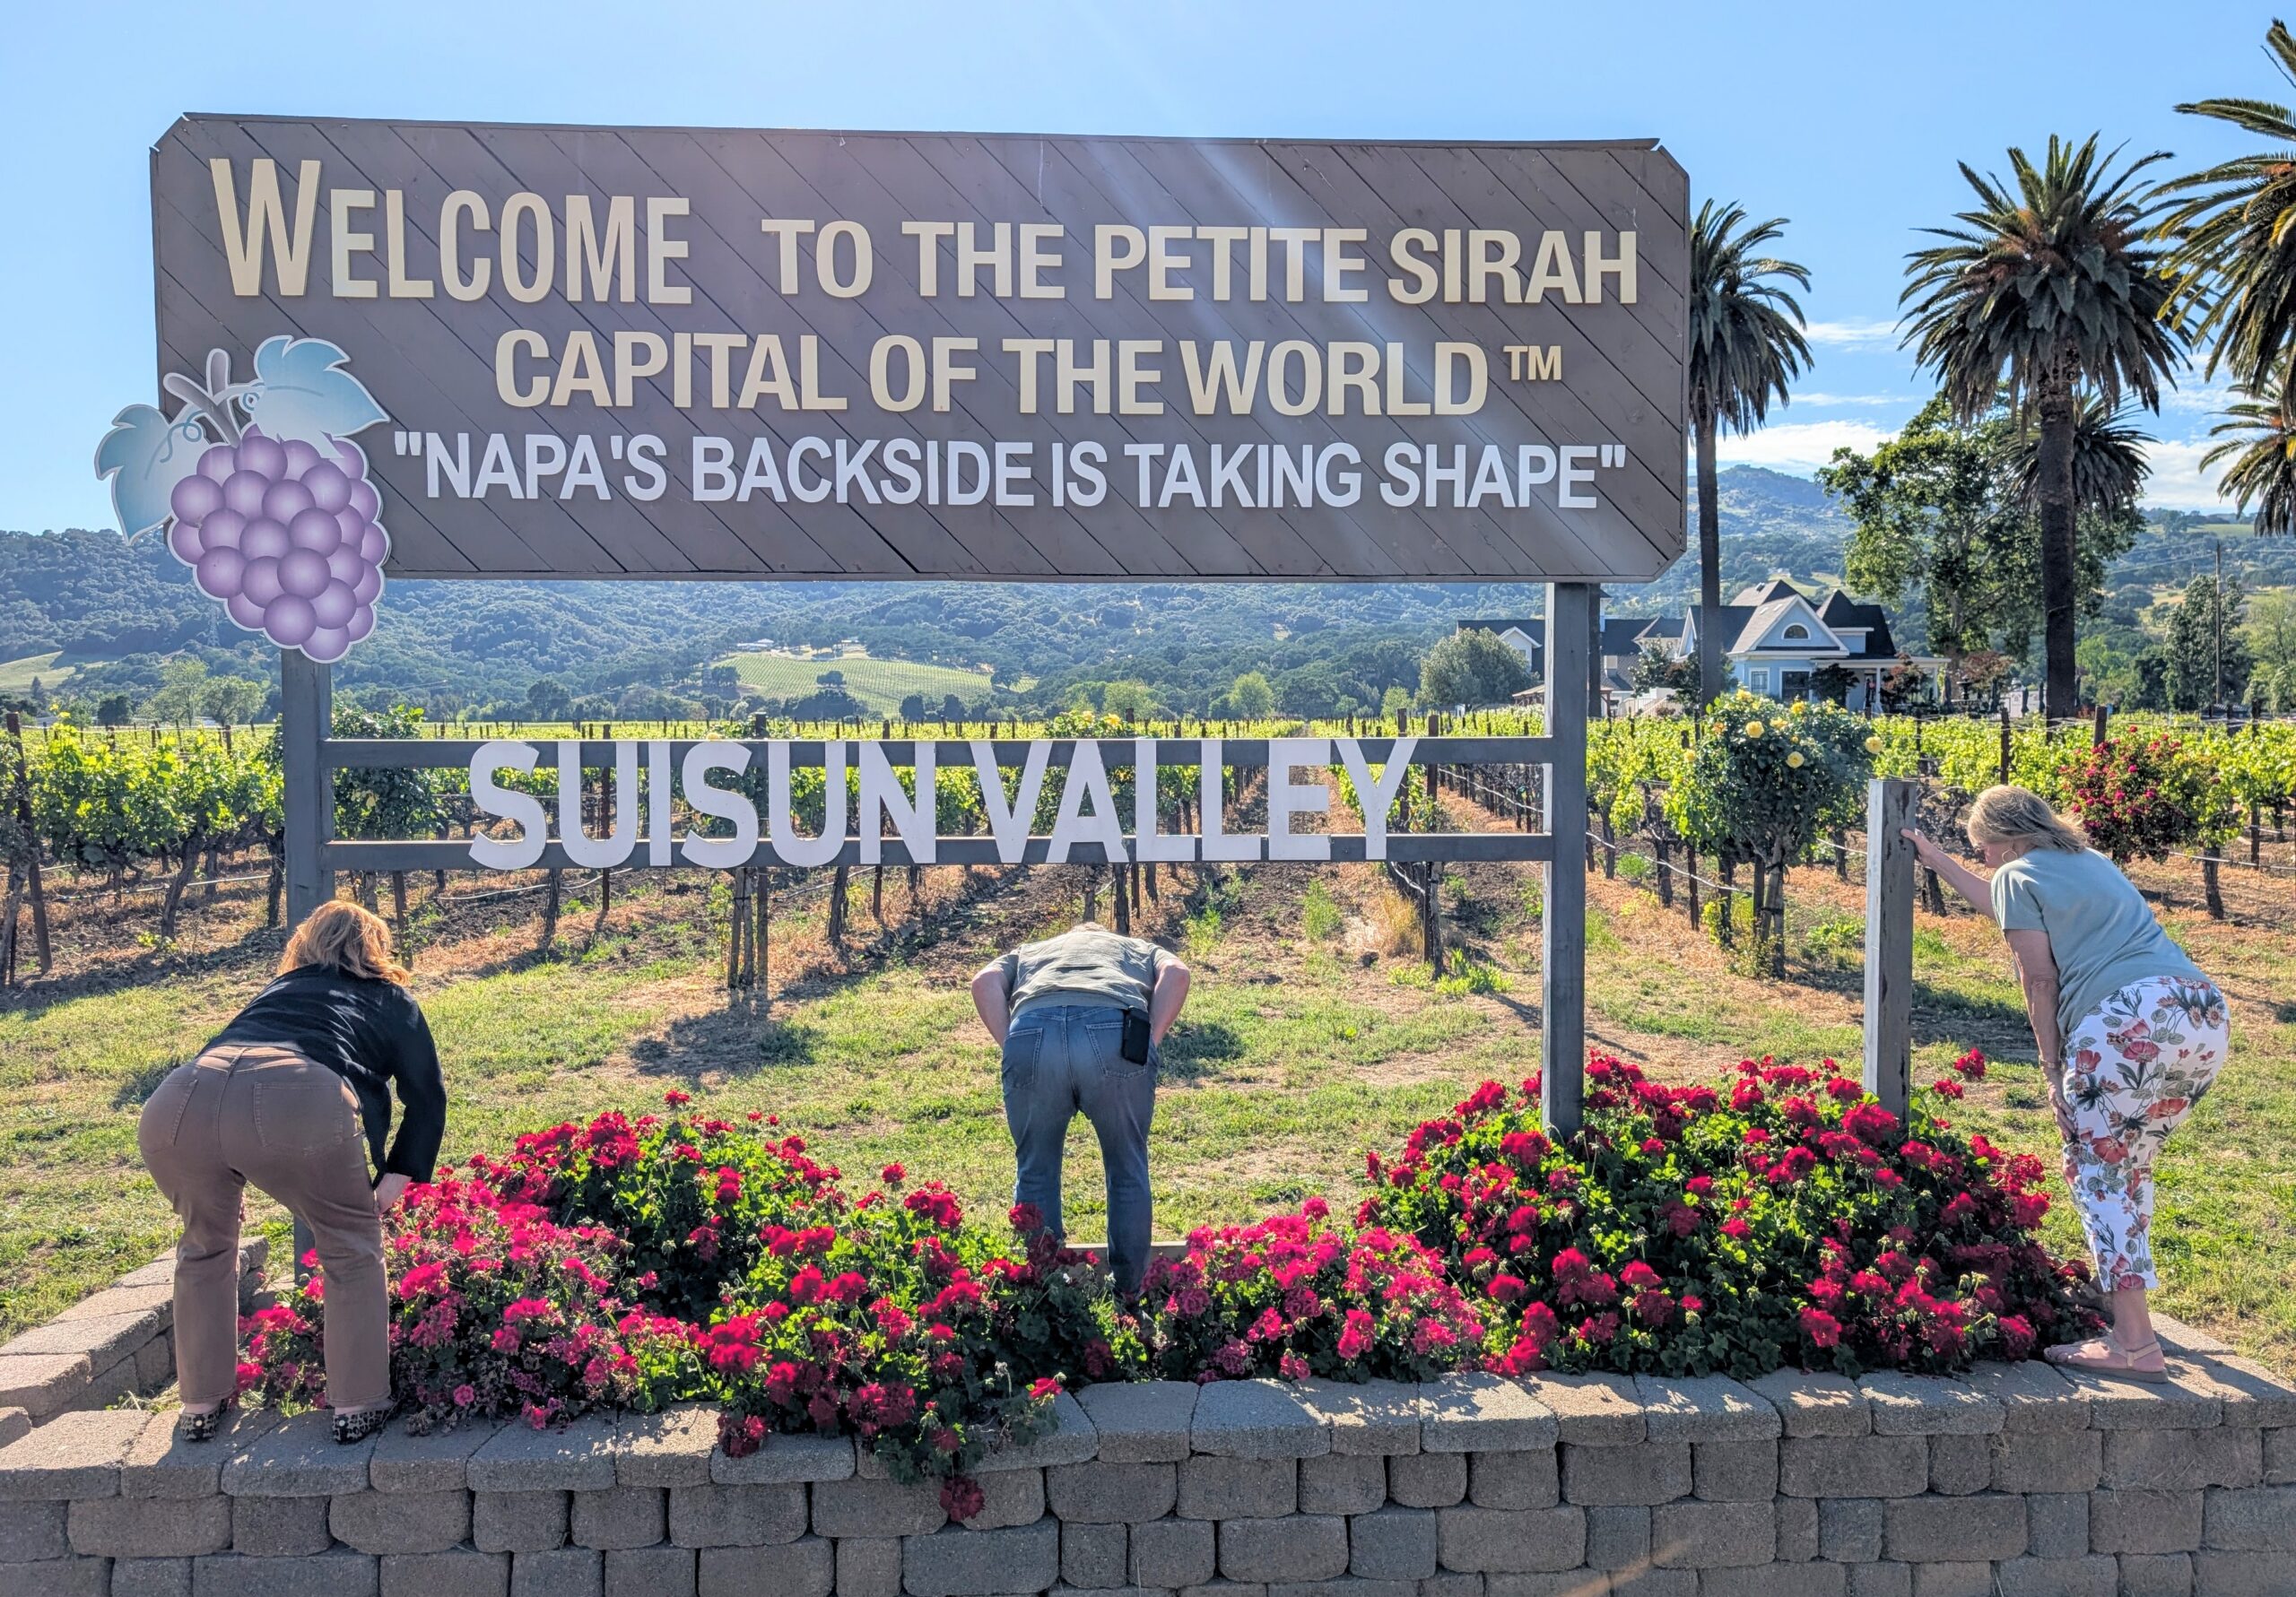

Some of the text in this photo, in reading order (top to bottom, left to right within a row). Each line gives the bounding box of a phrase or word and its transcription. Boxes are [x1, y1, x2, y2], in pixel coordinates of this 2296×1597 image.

[761, 219, 874, 298] TO
[901, 221, 1065, 299] THE
[1095, 224, 1369, 302] PETITE
[1387, 229, 1638, 305] SIRAH
[496, 329, 848, 411] CAPITAL
[870, 334, 978, 412] OF
[1002, 339, 1164, 415] THE
[1180, 340, 1489, 416] WORLD
[394, 430, 1627, 509] "NAPA'S BACKSIDE IS TAKING SHAPE"
[468, 737, 1417, 869] SUISUN VALLEY
